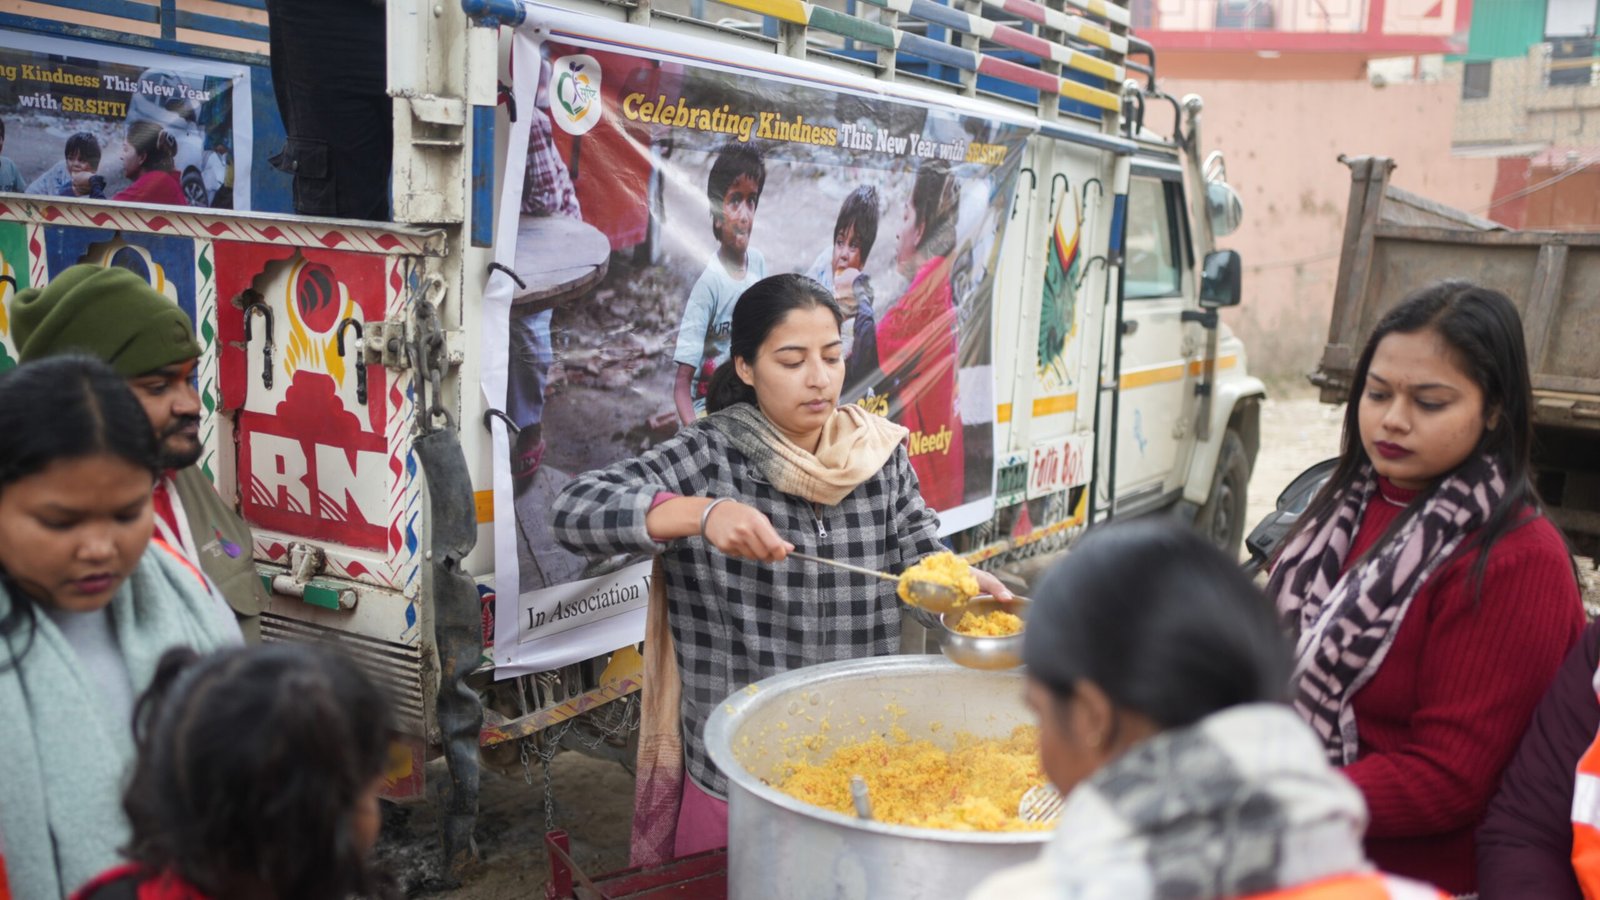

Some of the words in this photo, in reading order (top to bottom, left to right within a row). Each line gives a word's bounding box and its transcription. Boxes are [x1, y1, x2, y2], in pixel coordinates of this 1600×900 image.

[21, 64, 100, 88] Kindness
[103, 75, 138, 93] This
[141, 80, 175, 97] New
[178, 84, 210, 101] Year
[18, 92, 58, 110] with
[61, 96, 127, 117] SRSHTI
[622, 92, 755, 142] Celebrating
[756, 111, 838, 147] Kindness
[840, 122, 873, 150] This
[875, 127, 907, 154] New
[908, 133, 936, 158] Year
[938, 137, 965, 161] with
[908, 424, 953, 457] Needy
[527, 606, 546, 631] In
[549, 582, 640, 623] Association
